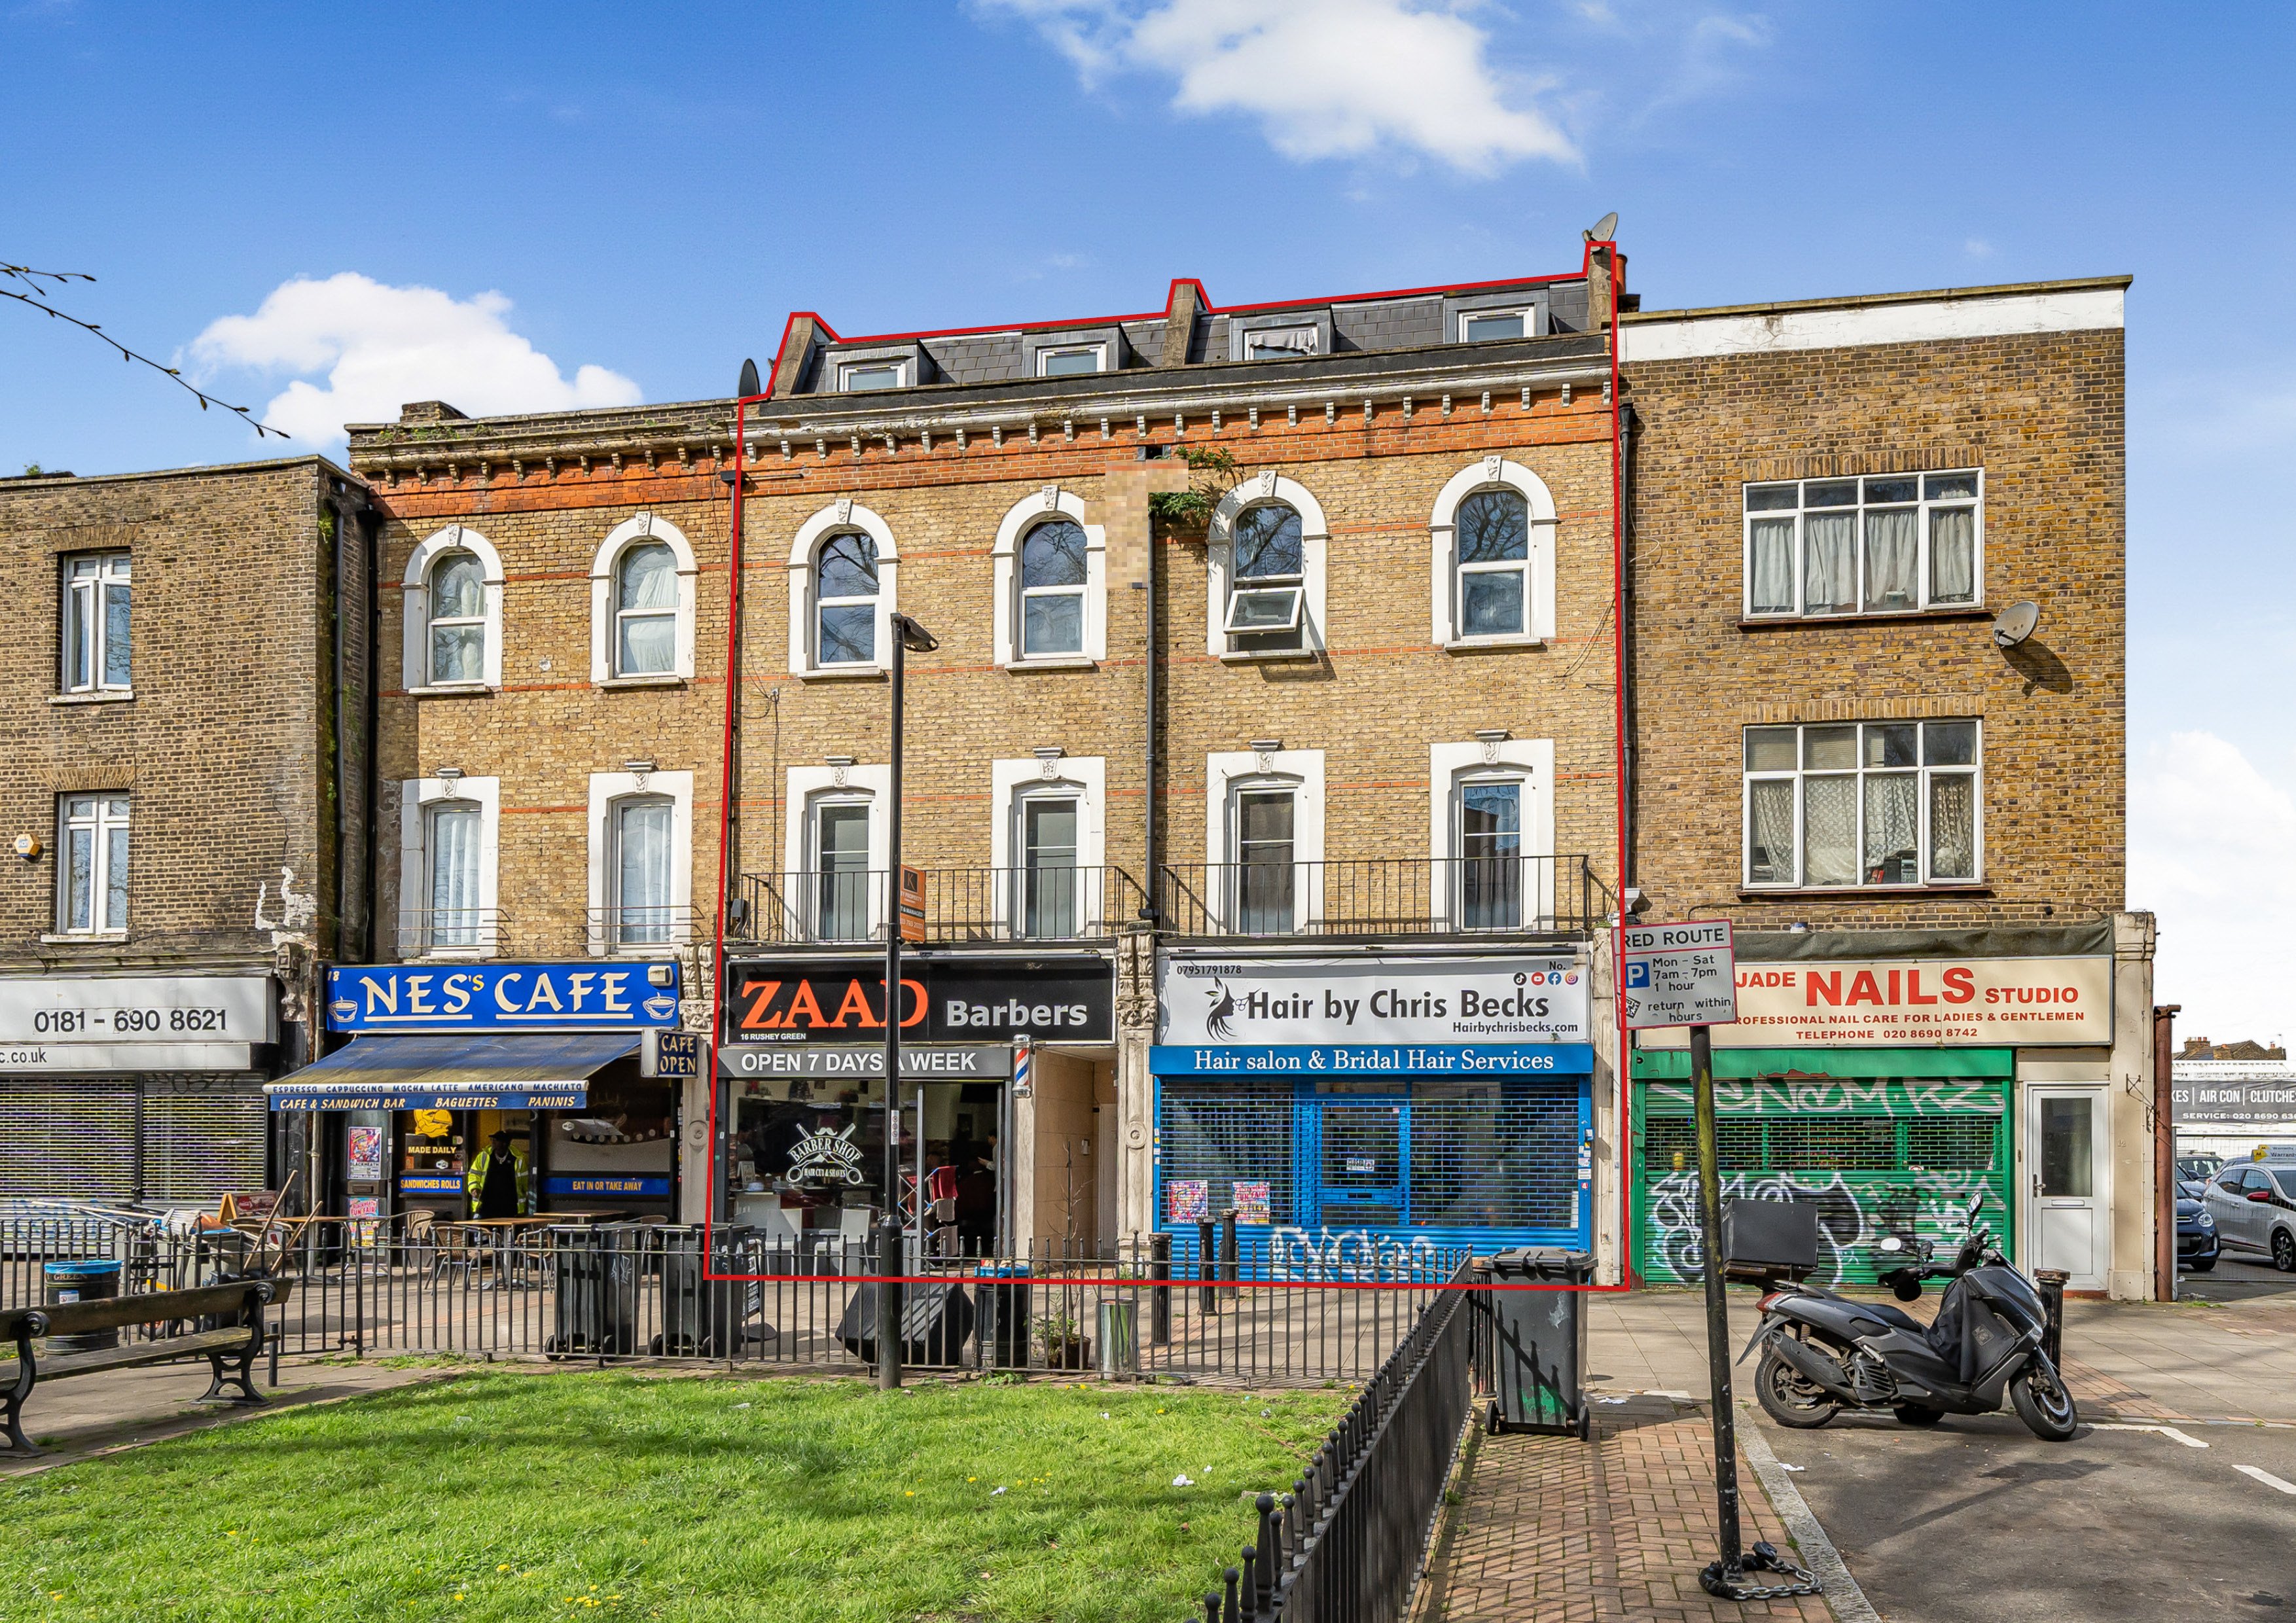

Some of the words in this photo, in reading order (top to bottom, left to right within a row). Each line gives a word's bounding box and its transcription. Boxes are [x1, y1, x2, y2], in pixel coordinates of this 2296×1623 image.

[1663, 928, 1725, 946] ROUTE
[1549, 961, 1566, 971] No.
[1653, 957, 1678, 967] Mon
[1693, 955, 1715, 965] Sat
[327, 971, 340, 982] 18
[1177, 965, 1242, 975] 07951791878
[1627, 965, 1644, 986] P
[1653, 970, 1679, 980] 7am
[1691, 968, 1717, 979] 7pm
[494, 972, 632, 1013] CAFE
[1654, 982, 1659, 991] 1
[1668, 982, 1695, 991] hour
[1735, 972, 1796, 988] JADE
[1806, 967, 1975, 1007] NAILS
[1984, 987, 2079, 1004] STUDIO
[740, 978, 929, 1029] ZAAD
[946, 999, 1088, 1027] Barbers
[1247, 991, 1314, 1020] Hair
[1324, 989, 1360, 1026] by
[1369, 988, 1447, 1018] Chris
[1460, 988, 1549, 1018] Becks
[1648, 1001, 1685, 1011] return
[1695, 997, 1731, 1008] within
[34, 1010, 85, 1033] 0181
[114, 1010, 160, 1032] 690
[170, 1009, 226, 1031] 8621
[1669, 1012, 1702, 1022] hours
[1737, 1016, 1825, 1025] ROFESSIONAL
[1829, 1015, 1859, 1024] NAIL
[1863, 1015, 1899, 1024] CARE
[1904, 1014, 1931, 1023] FOR
[1934, 1012, 1983, 1022] LADIES
[1987, 1012, 1996, 1022] &
[2000, 1012, 2085, 1021] GENTLEMEN
[1452, 1021, 1578, 1035] Hairbychrisbecks.com
[1796, 1030, 1874, 1039] TELEPHONE
[1884, 1029, 1906, 1039] 020
[1910, 1029, 1942, 1038] 8690
[1946, 1028, 1978, 1037] 8742
[661, 1035, 694, 1054] CAFE
[660, 1056, 697, 1074] OPEN
[742, 1053, 800, 1071] OPEN
[808, 1054, 819, 1071] 7
[826, 1053, 884, 1071] DAYS
[909, 1052, 977, 1071] WEEK
[1194, 1050, 1241, 1070] Hair
[1246, 1050, 1302, 1070] salon
[1308, 1050, 1326, 1069] &
[1333, 1049, 1399, 1070] Bridal
[1407, 1049, 1456, 1070] Hair
[1461, 1049, 1554, 1070] Services
[279, 1099, 307, 1109] CAFE
[310, 1099, 317, 1109] &
[321, 1098, 383, 1109] SANDWICH
[383, 1098, 406, 1108] BAR
[435, 1097, 498, 1107] BAGUETTES
[528, 1096, 575, 1107] PANINIS
[2199, 1090, 2217, 1103] AIR
[2219, 1090, 2240, 1103] CON
[2250, 1090, 2296, 1103] CLUTCHE
[789, 1138, 831, 1162] BARBER
[833, 1139, 861, 1163] SHOP
[804, 1168, 816, 1177] HAIR
[829, 1168, 846, 1177] SHAVES
[401, 1179, 440, 1188] SANDWICHES
[440, 1179, 461, 1189] ROLLS
[573, 1181, 585, 1190] EAT
[586, 1181, 593, 1190] IN
[595, 1181, 604, 1190] OR
[605, 1181, 622, 1190] TAKE
[624, 1181, 643, 1191] AWAY
